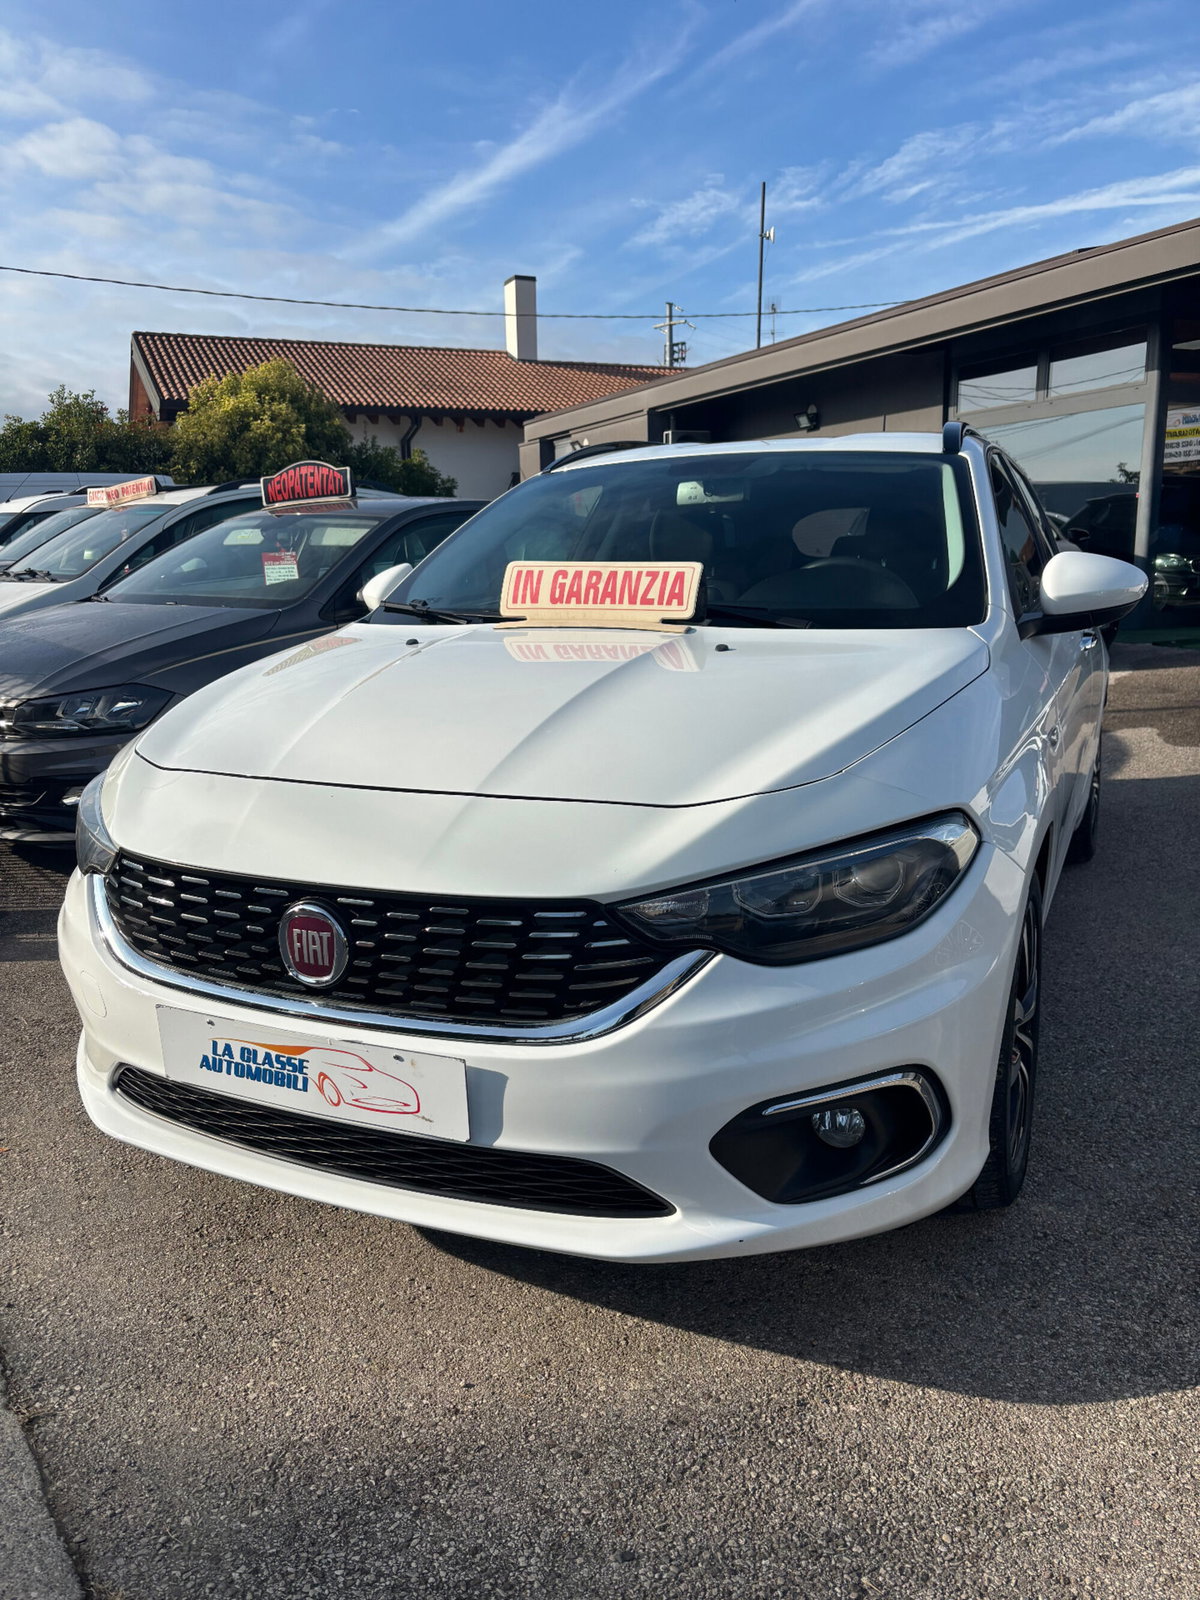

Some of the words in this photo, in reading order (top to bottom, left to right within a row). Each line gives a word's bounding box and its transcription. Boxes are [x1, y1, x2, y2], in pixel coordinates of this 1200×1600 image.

[106, 488, 120, 502] NEO
[267, 465, 345, 503] NEOPATENTATI
[511, 569, 544, 605] IN
[550, 569, 686, 607] GARANZIA
[292, 928, 332, 967] FIAT
[199, 1054, 309, 1093] AUTOMOBILI
[212, 1040, 235, 1060] LA
[239, 1046, 310, 1076] CLASSE
